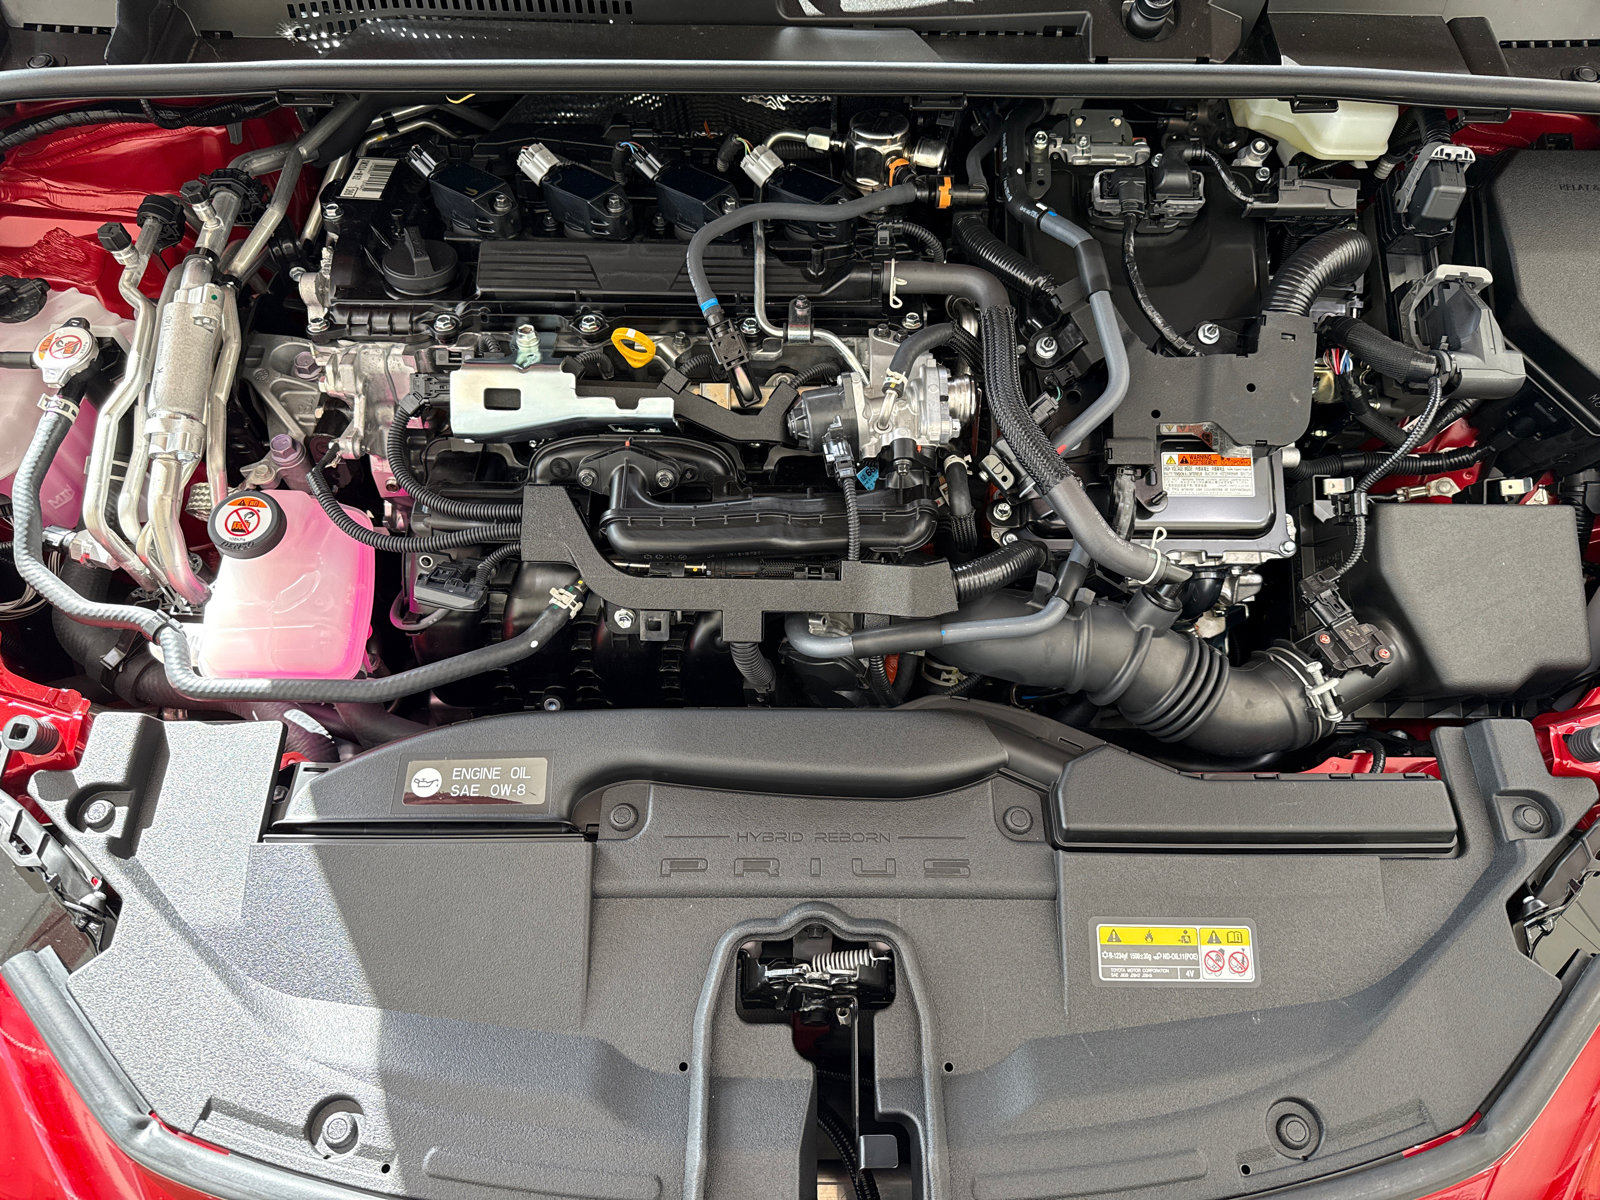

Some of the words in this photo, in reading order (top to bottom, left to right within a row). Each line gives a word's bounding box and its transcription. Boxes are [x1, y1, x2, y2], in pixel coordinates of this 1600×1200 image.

[452, 767, 501, 780] ENGINE
[510, 766, 531, 779] OIL
[450, 784, 480, 797] SAE
[737, 832, 804, 843] HYBRID
[814, 832, 891, 843] REBORN
[660, 857, 971, 879] PRIUS
